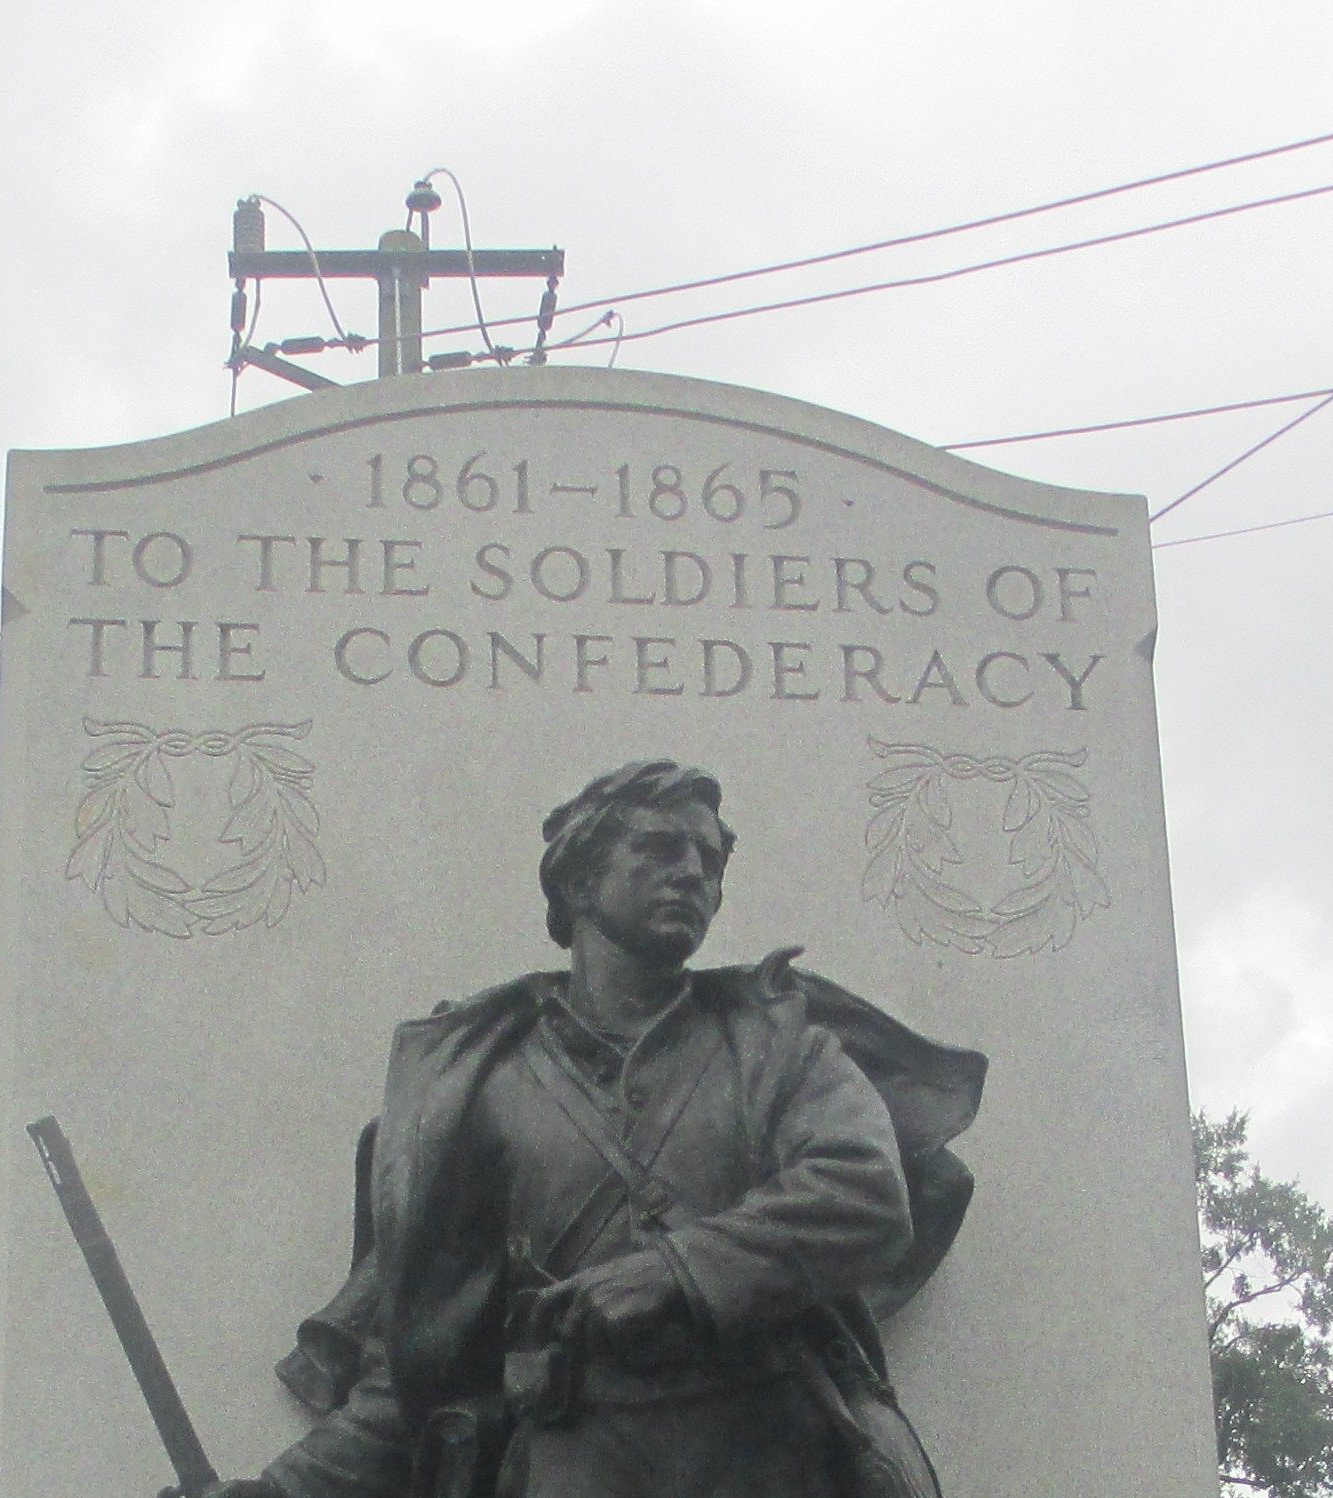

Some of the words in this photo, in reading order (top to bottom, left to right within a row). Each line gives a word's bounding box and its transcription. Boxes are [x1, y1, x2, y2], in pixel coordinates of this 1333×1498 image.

[70, 527, 194, 589] TO
[236, 533, 431, 597] THE
[470, 541, 940, 618] SOLDIERS
[985, 563, 1098, 623] OF
[69, 616, 267, 682] THE
[334, 626, 1106, 712] CONFEDERACY
